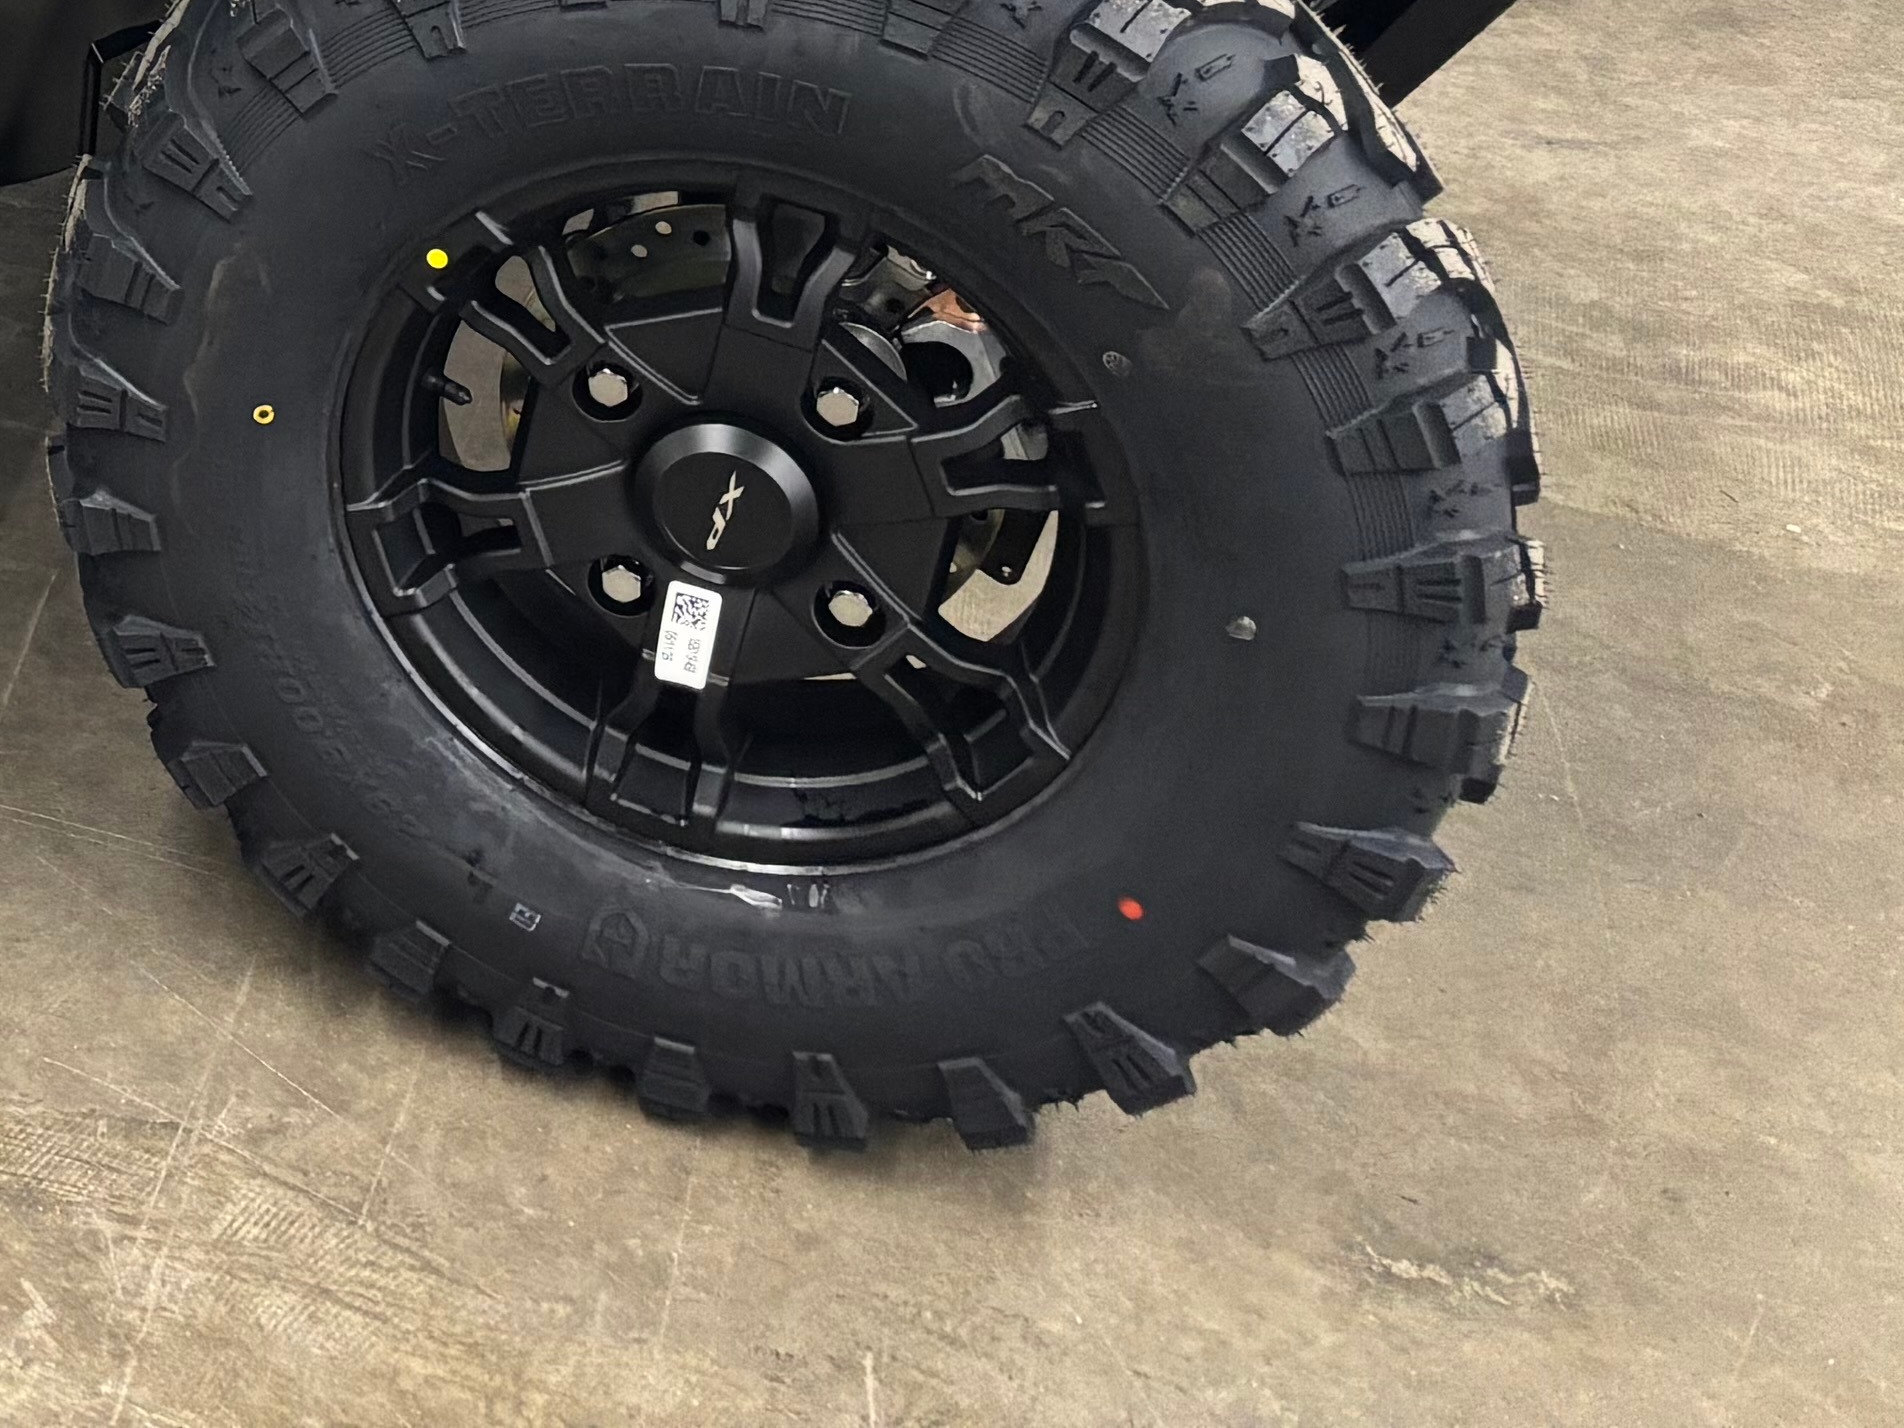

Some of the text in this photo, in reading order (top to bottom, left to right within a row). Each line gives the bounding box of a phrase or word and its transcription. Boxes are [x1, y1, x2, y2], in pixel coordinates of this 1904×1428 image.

[364, 62, 853, 184] X-TERRAIN
[706, 470, 746, 551] XP
[658, 934, 930, 1008] ARMOR
